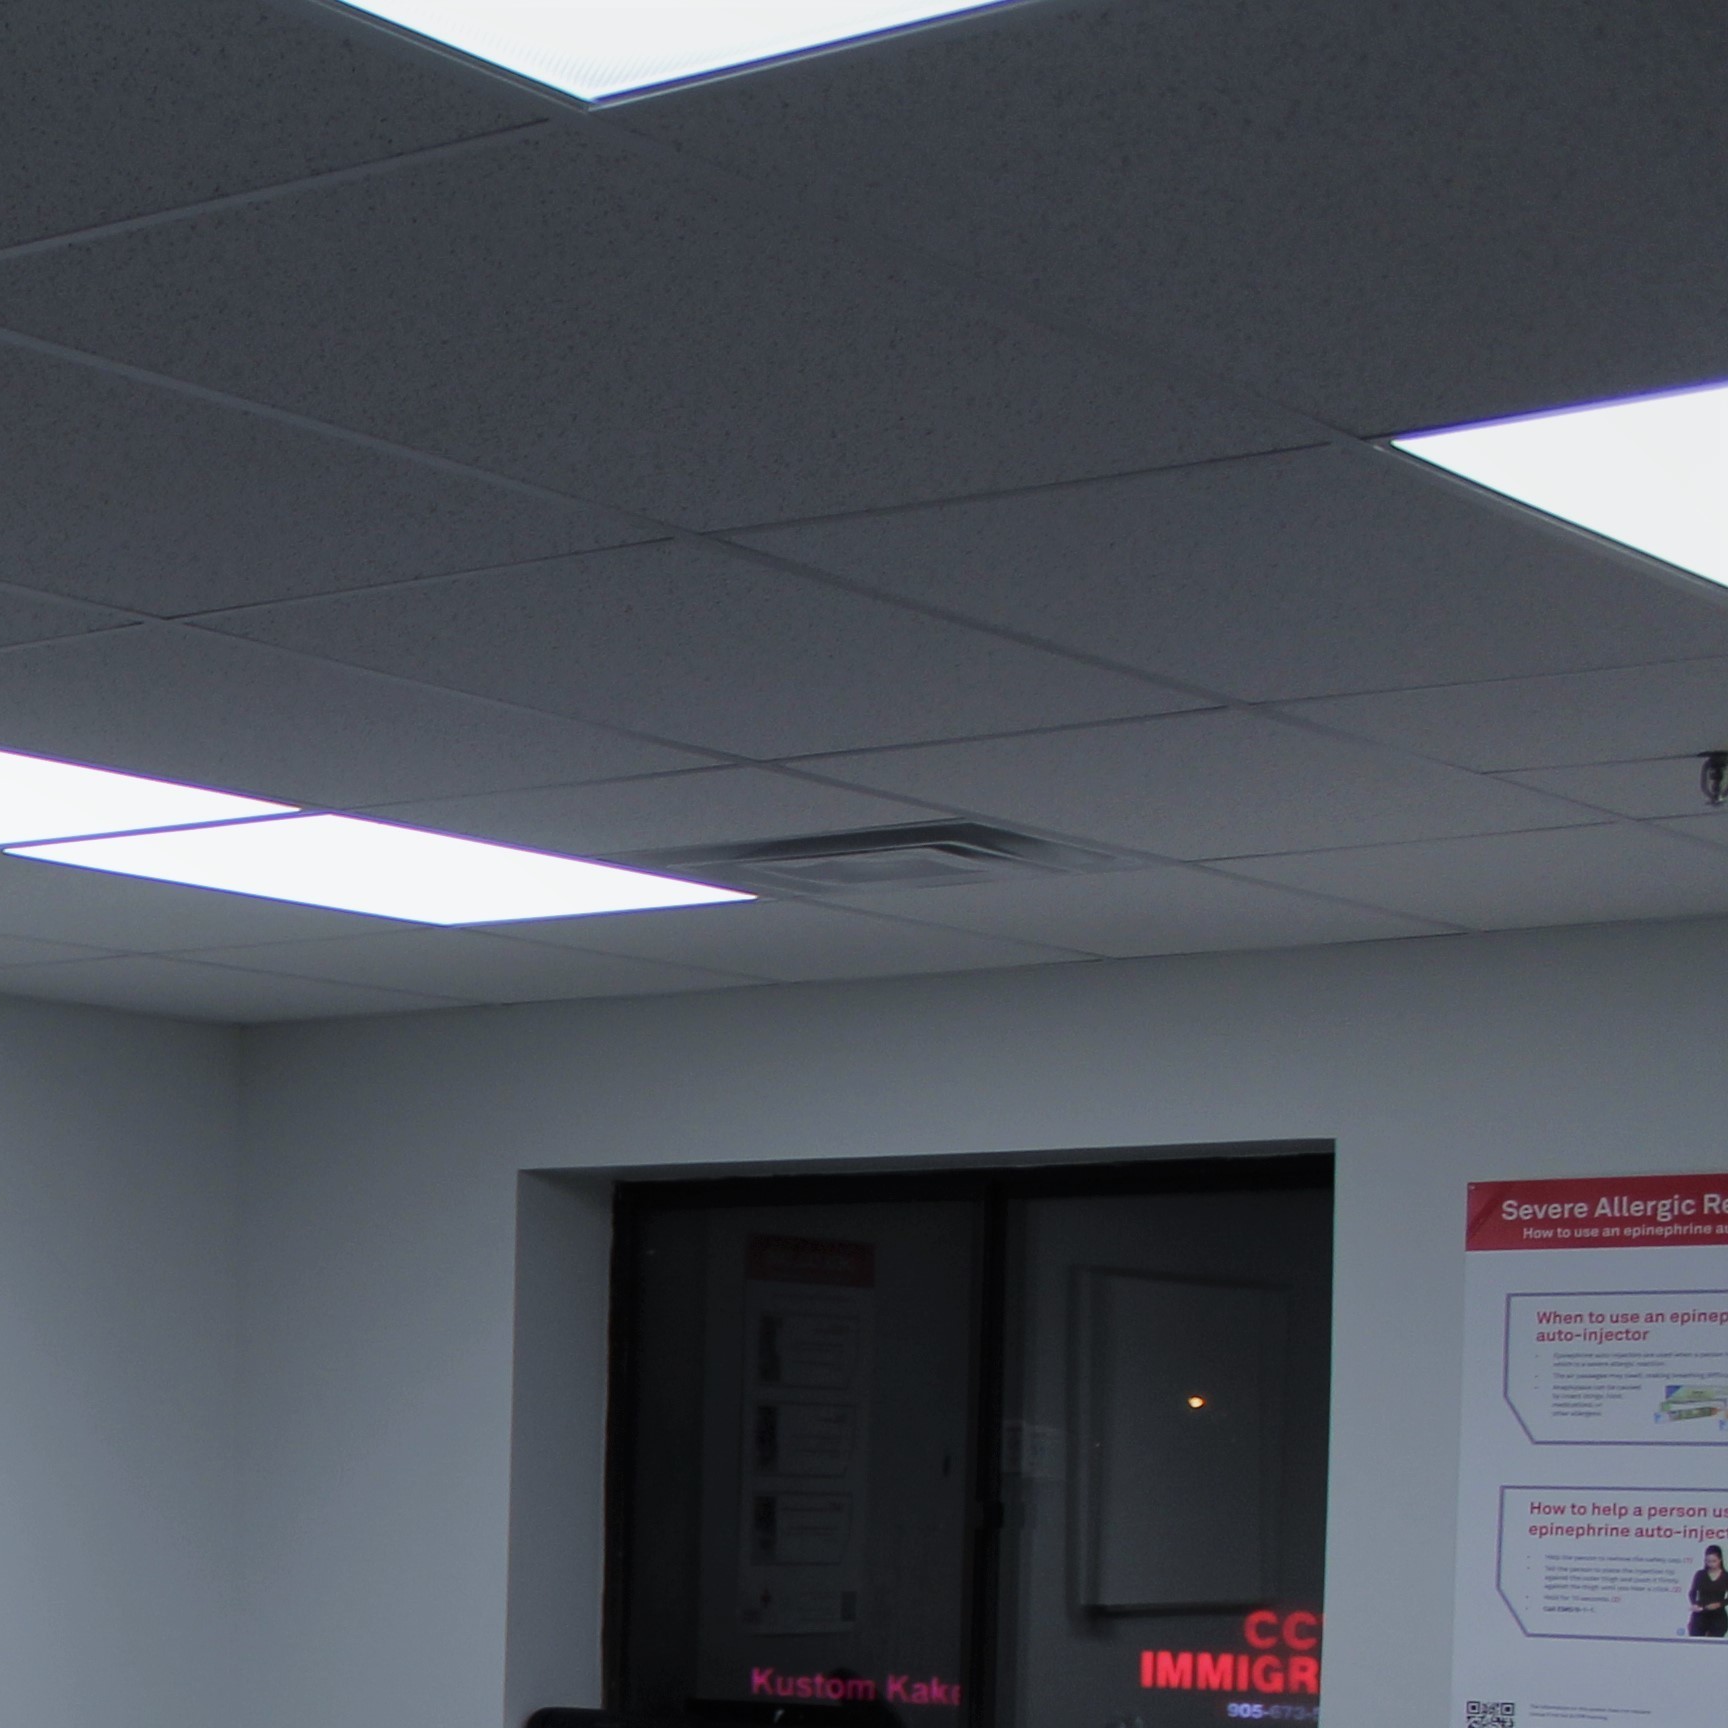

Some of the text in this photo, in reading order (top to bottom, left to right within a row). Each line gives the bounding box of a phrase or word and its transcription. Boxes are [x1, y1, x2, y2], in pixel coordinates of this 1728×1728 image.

[1501, 1200, 1589, 1221] Severe
[1594, 1195, 1696, 1222] Allergic
[1523, 1227, 1553, 1239] How
[1557, 1227, 1571, 1238] to
[1574, 1227, 1599, 1237] use
[1602, 1227, 1620, 1237] an
[1623, 1223, 1712, 1238] epinephrine
[1536, 1309, 1728, 1326] When to use an epinep
[1536, 1328, 1650, 1344] auto-injector
[1530, 1502, 1565, 1515] How
[1571, 1503, 1587, 1516] to
[1591, 1503, 1628, 1519] help
[1633, 1506, 1643, 1517] a
[1647, 1505, 1707, 1520] person
[1529, 1522, 1630, 1539] epinephrine
[1140, 1649, 1320, 1695] IMMIGR
[750, 1666, 877, 1701] Kustom
